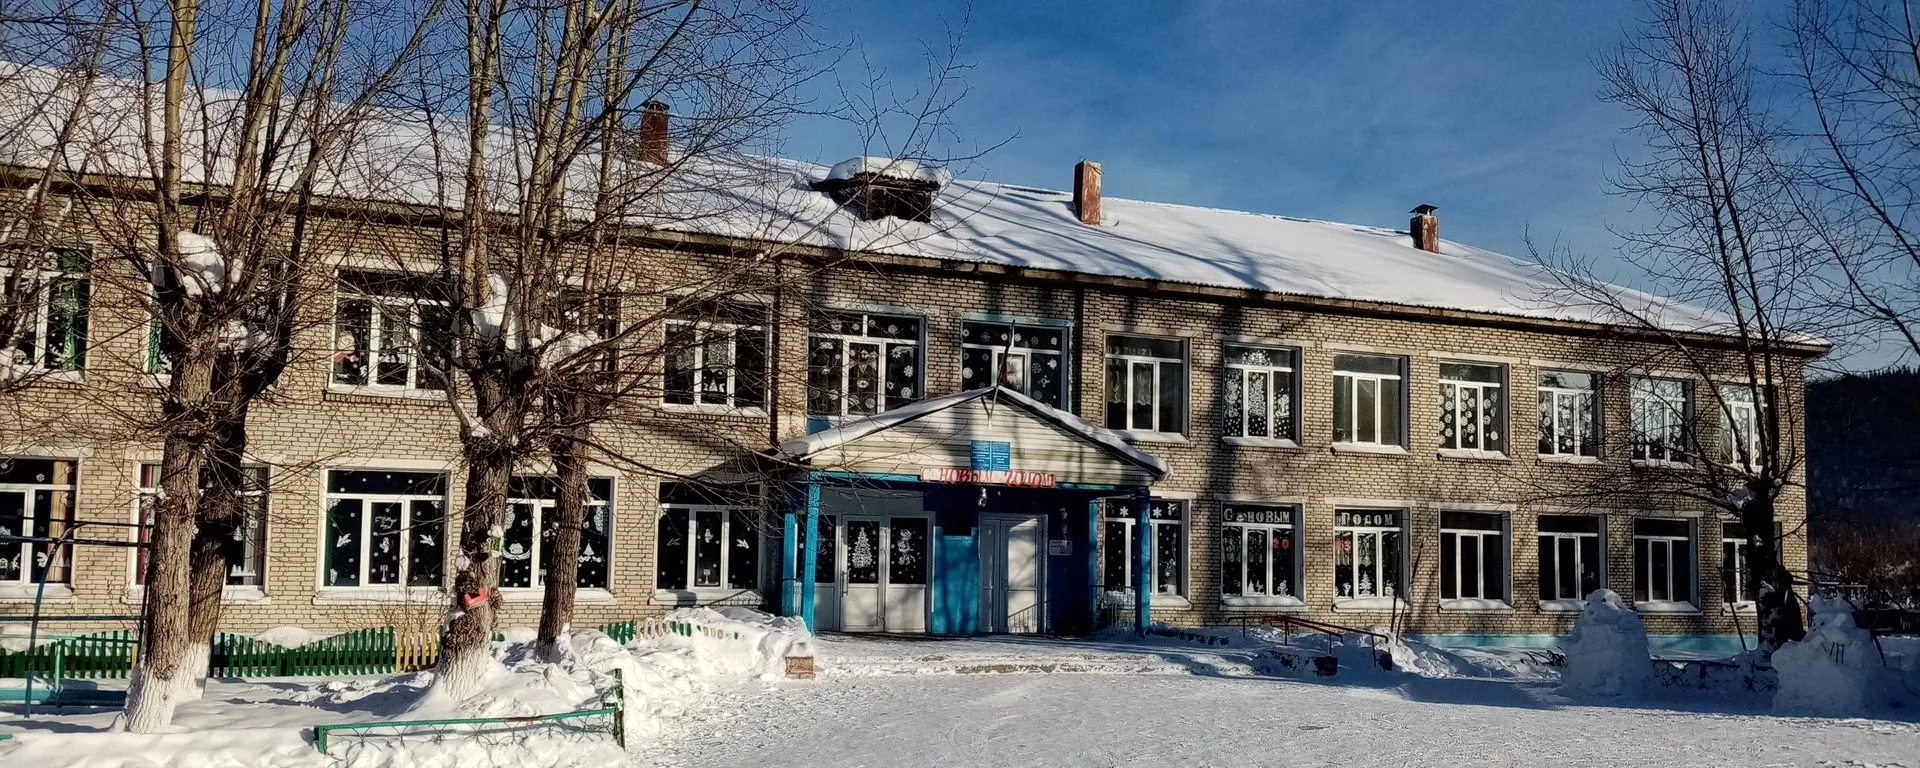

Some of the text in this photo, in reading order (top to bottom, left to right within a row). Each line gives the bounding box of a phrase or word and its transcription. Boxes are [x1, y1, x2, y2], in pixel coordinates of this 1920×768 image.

[1223, 508, 1290, 523] С НОВЫМ
[1341, 512, 1393, 526] ГОДОМ
